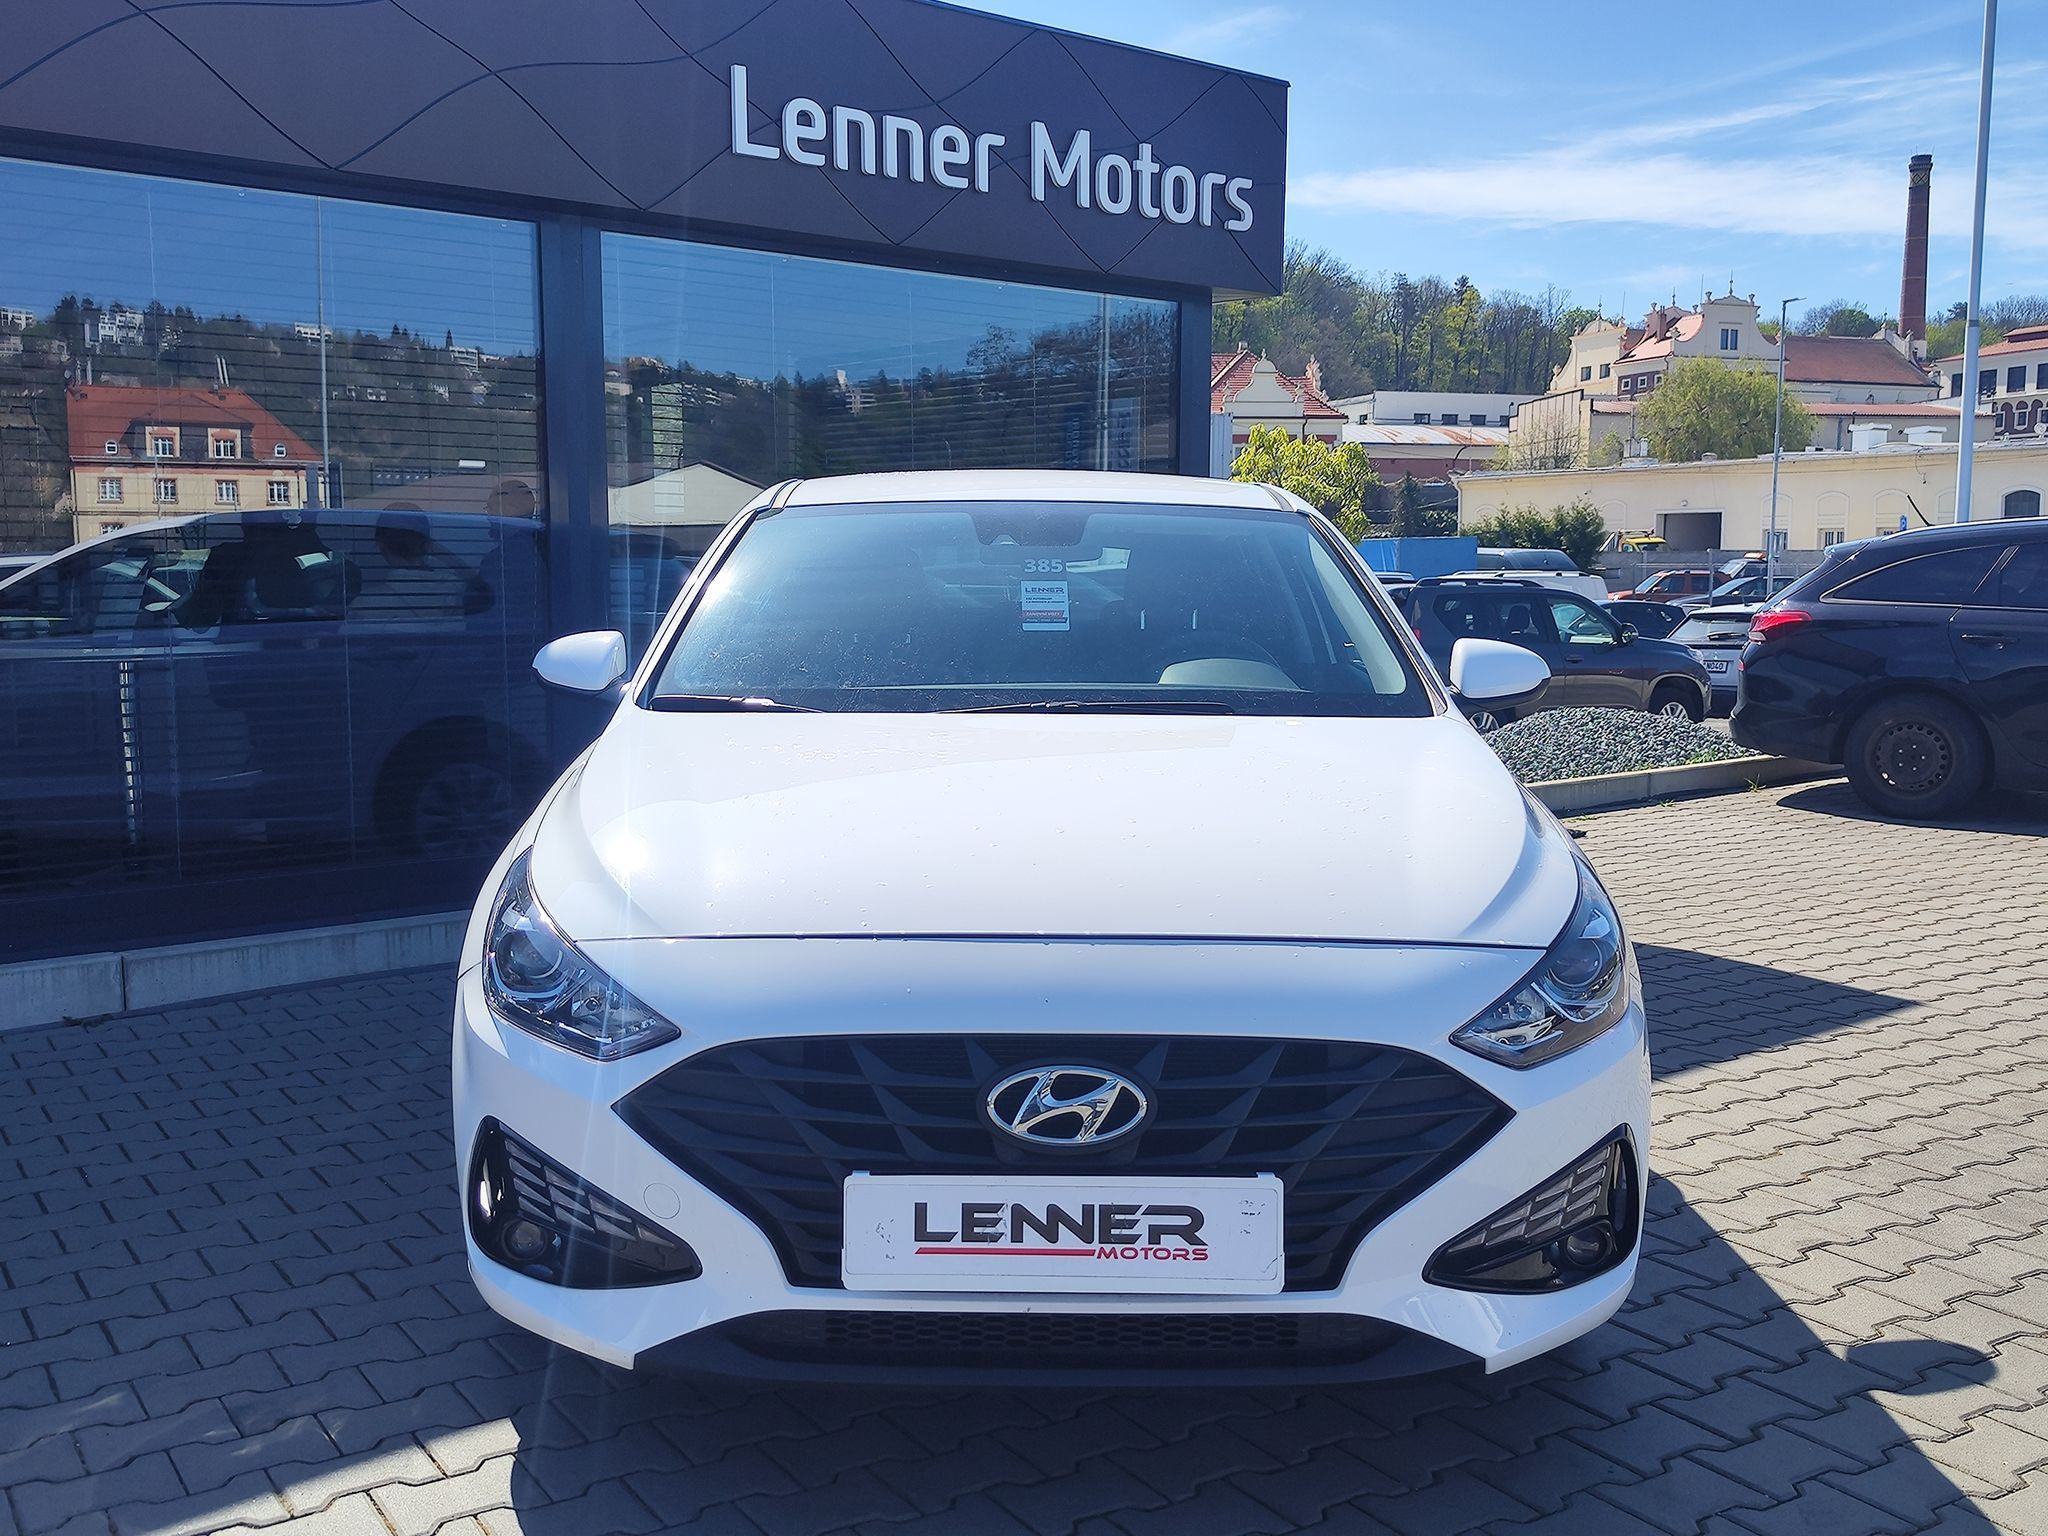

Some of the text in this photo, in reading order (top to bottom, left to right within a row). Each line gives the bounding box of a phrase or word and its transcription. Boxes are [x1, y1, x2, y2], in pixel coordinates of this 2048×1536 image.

[730, 63, 1254, 232] Lenner Motors
[1024, 558, 1063, 573] 385
[914, 1202, 1209, 1246] LENNER
[1096, 1246, 1209, 1261] MOTORS
